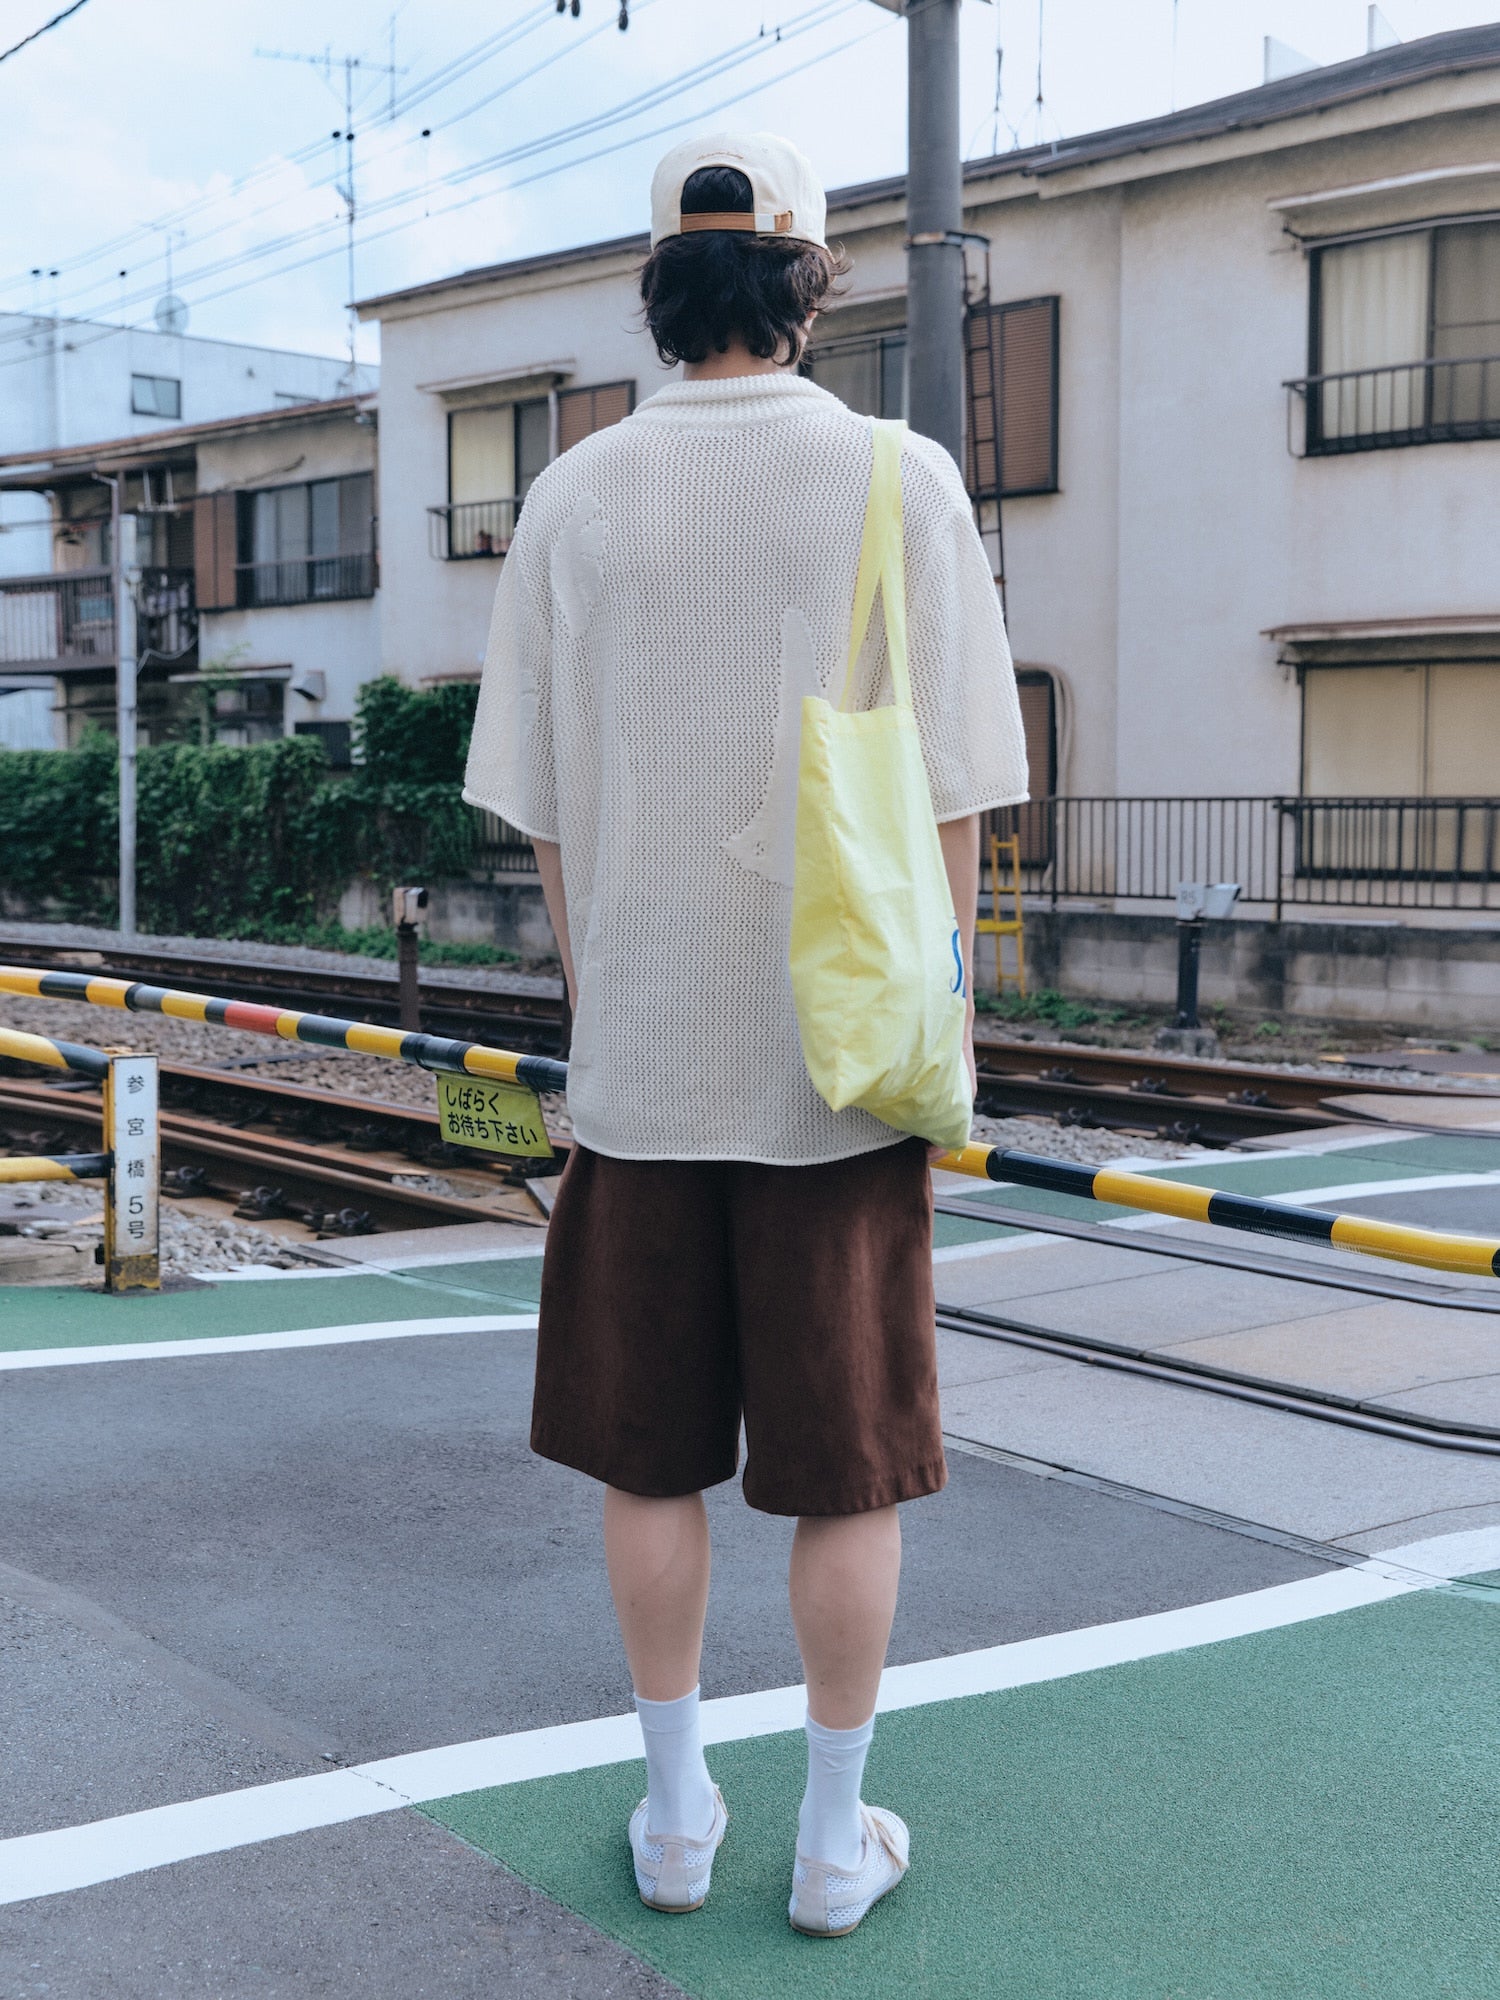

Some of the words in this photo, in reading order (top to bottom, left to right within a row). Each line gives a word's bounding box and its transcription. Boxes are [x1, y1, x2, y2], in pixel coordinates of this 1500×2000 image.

[445, 1084, 500, 1116] しばらく
[447, 1111, 539, 1146] お待ち下さい
[127, 1075, 145, 1240] 参宮橋5号
